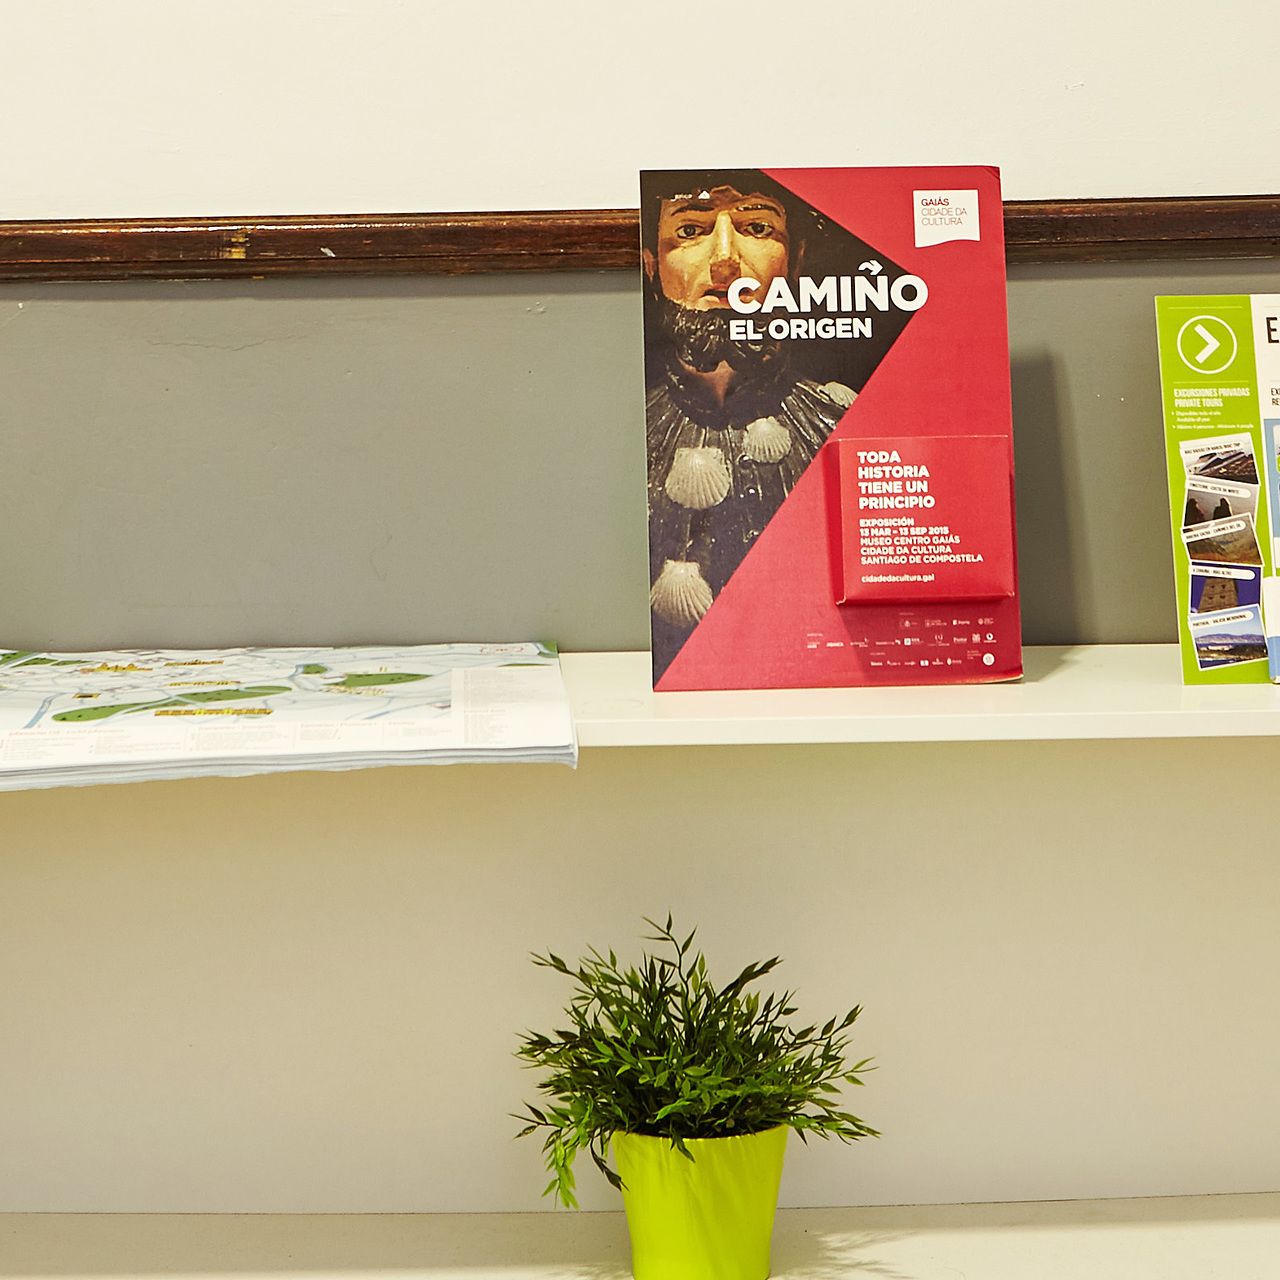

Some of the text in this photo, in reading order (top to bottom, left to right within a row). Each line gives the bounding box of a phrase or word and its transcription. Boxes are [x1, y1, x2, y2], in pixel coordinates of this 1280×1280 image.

[921, 198, 949, 206] GAIÁS
[921, 208, 967, 216] CIDADE DA
[921, 217, 962, 226] CULTURA
[727, 259, 928, 314] CAMIÑO
[729, 317, 871, 340] EL ORIGEN
[1174, 388, 1217, 397] EXCURSIONES
[1175, 398, 1223, 407] PRIVATE TOURS
[857, 450, 901, 463] TODA
[858, 465, 929, 479] HISTORIA
[858, 481, 928, 494] TIENE UN
[859, 496, 935, 509] PRINCIPIO
[859, 516, 914, 527] EXPOSICIÓN
[871, 528, 891, 536] MAR
[910, 527, 927, 535] SEP
[928, 526, 949, 534] 2015
[860, 534, 960, 546] MUSEO CENTRO GAIÁS
[860, 546, 952, 555] CIDADE DA CULTURA
[861, 554, 983, 565] SANTIAGO DE COMPOSTELA
[861, 574, 934, 583] cidadedacultura.gal
